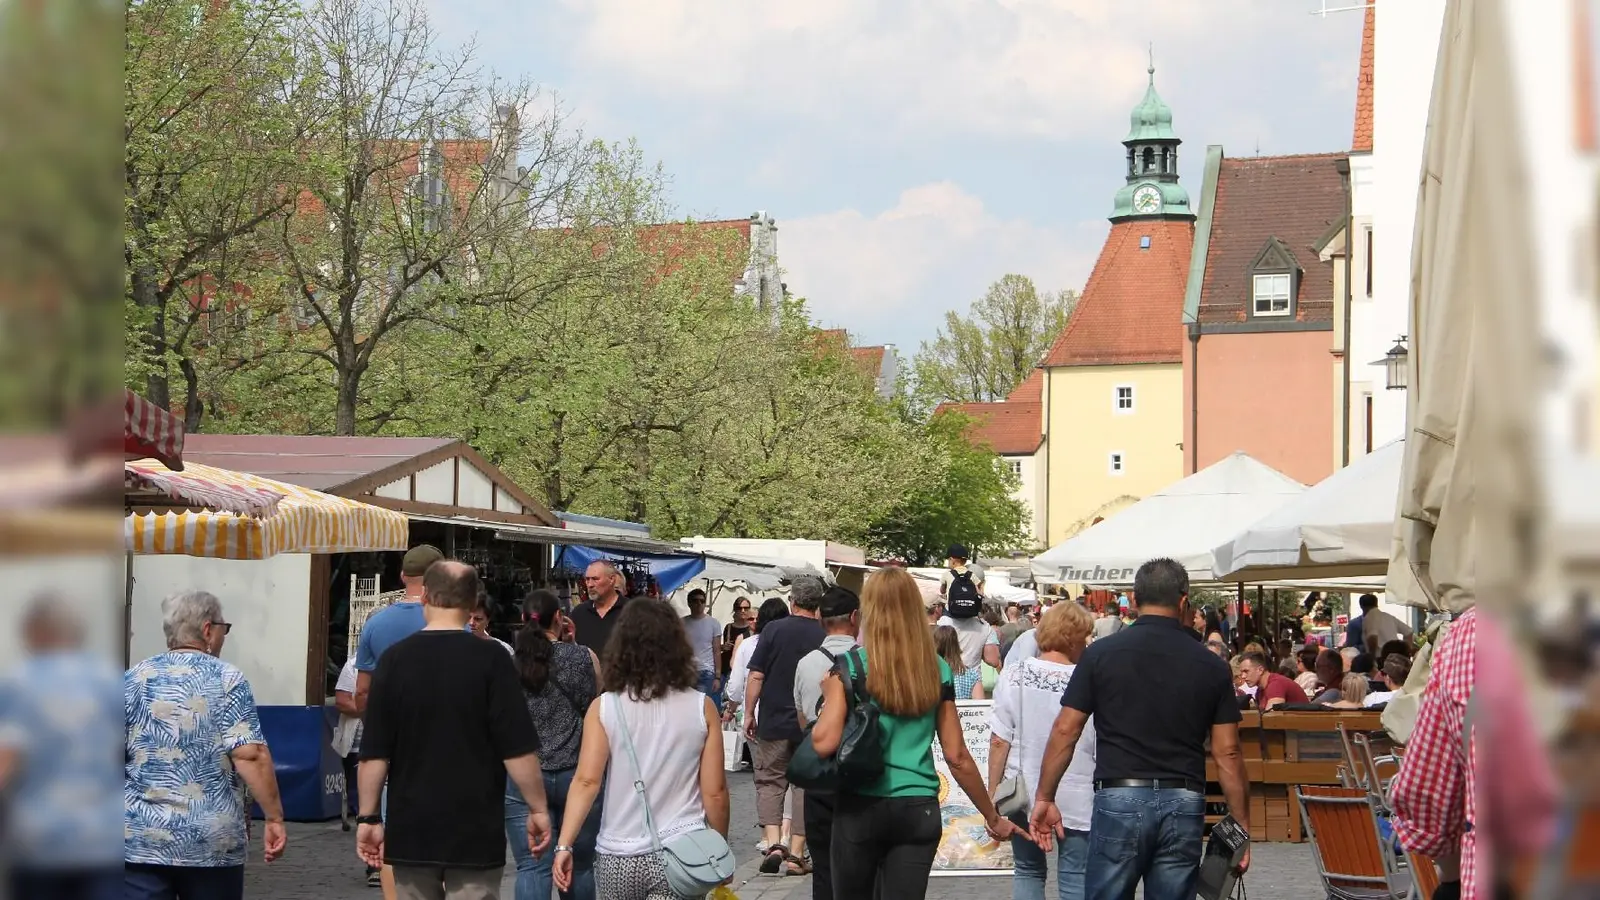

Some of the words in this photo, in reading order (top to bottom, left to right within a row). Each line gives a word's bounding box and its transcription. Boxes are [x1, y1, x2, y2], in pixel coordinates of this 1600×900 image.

[1058, 565, 1134, 581] Tucher
[958, 709, 984, 719] gäuer
[325, 772, 345, 794] 9243
